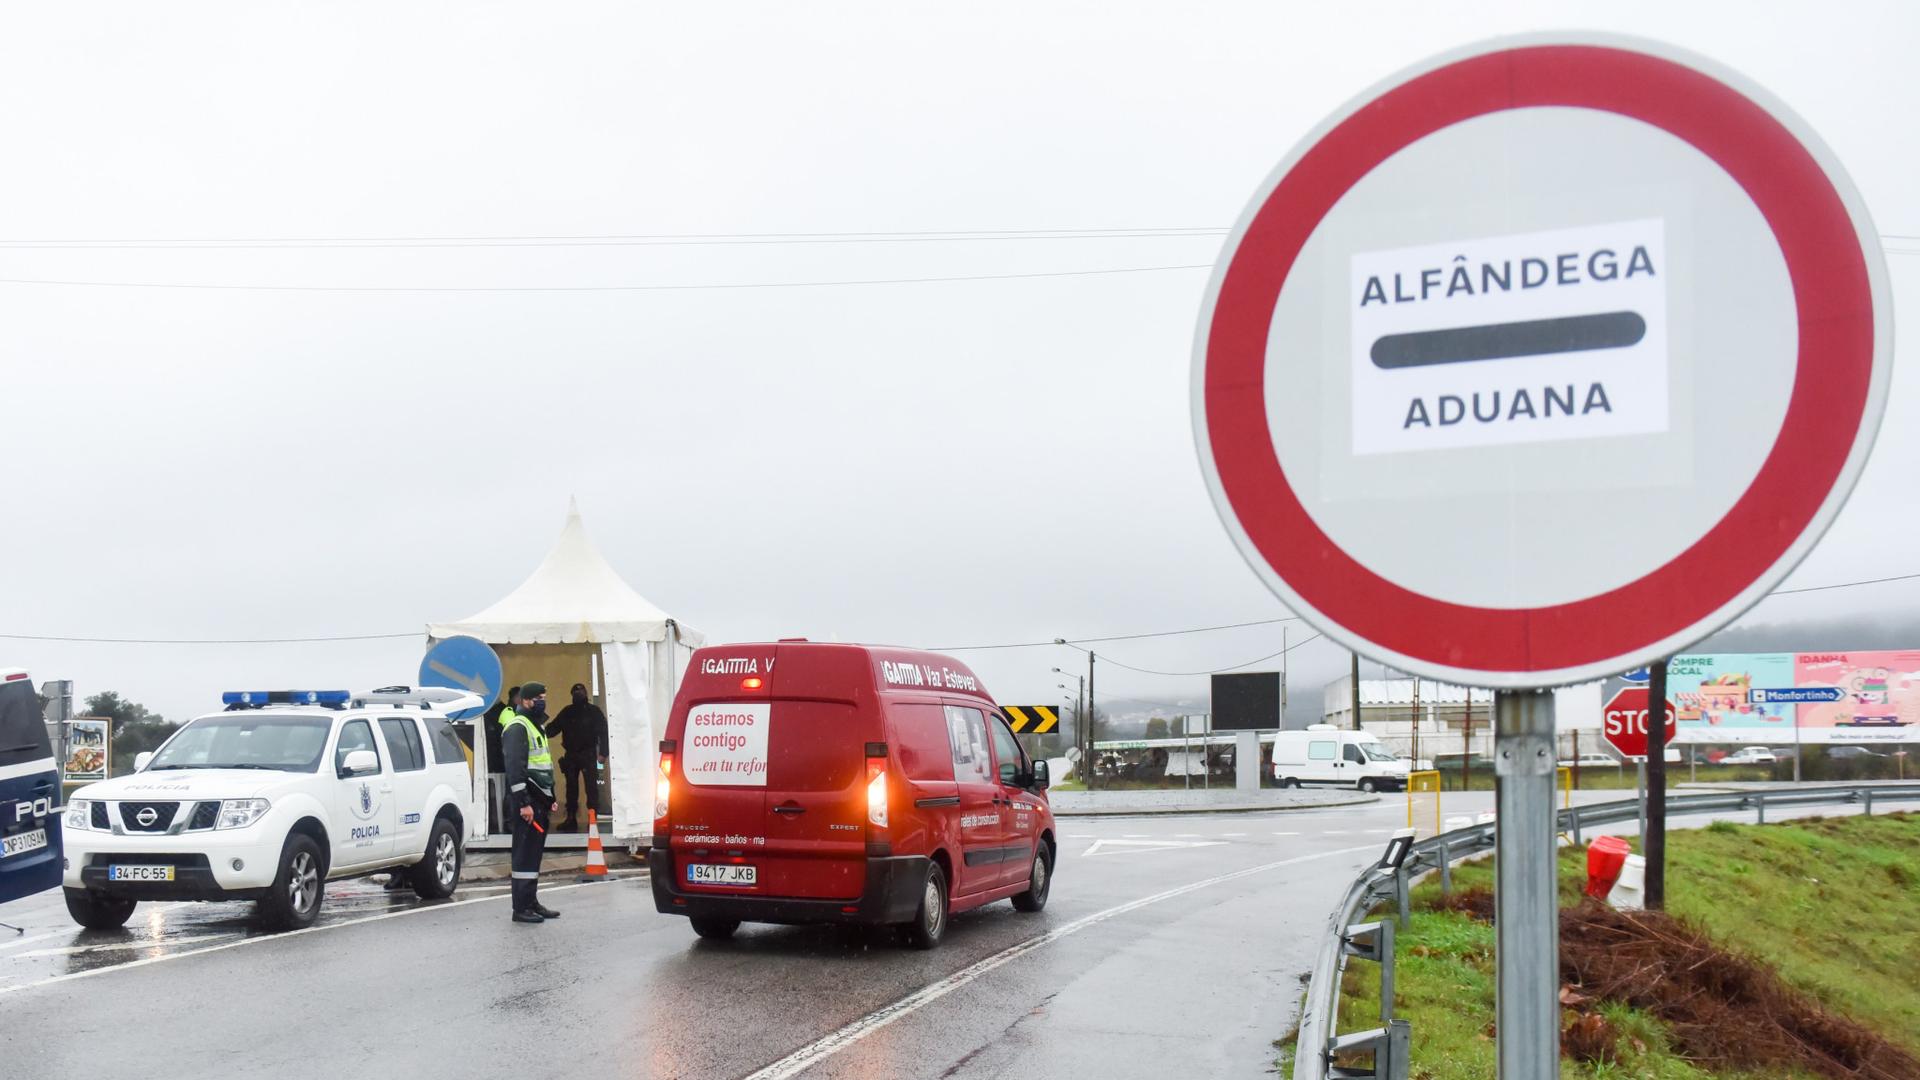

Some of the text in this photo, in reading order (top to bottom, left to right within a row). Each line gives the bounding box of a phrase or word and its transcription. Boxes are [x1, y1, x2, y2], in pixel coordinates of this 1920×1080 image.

[1360, 245, 1656, 307] ALFÂNDEGA
[1403, 382, 1613, 430] ADUANA
[765, 657, 775, 673] V
[923, 664, 943, 687] Vaz
[943, 666, 977, 691] Estevez
[1768, 690, 1836, 700] Monfortinho
[695, 712, 754, 726] estamos
[694, 732, 746, 751] contigo
[721, 759, 733, 772] tu
[351, 825, 380, 839] POLICIA
[684, 833, 765, 845] cerámicas baños ma
[696, 866, 754, 880] 9417 JKB
